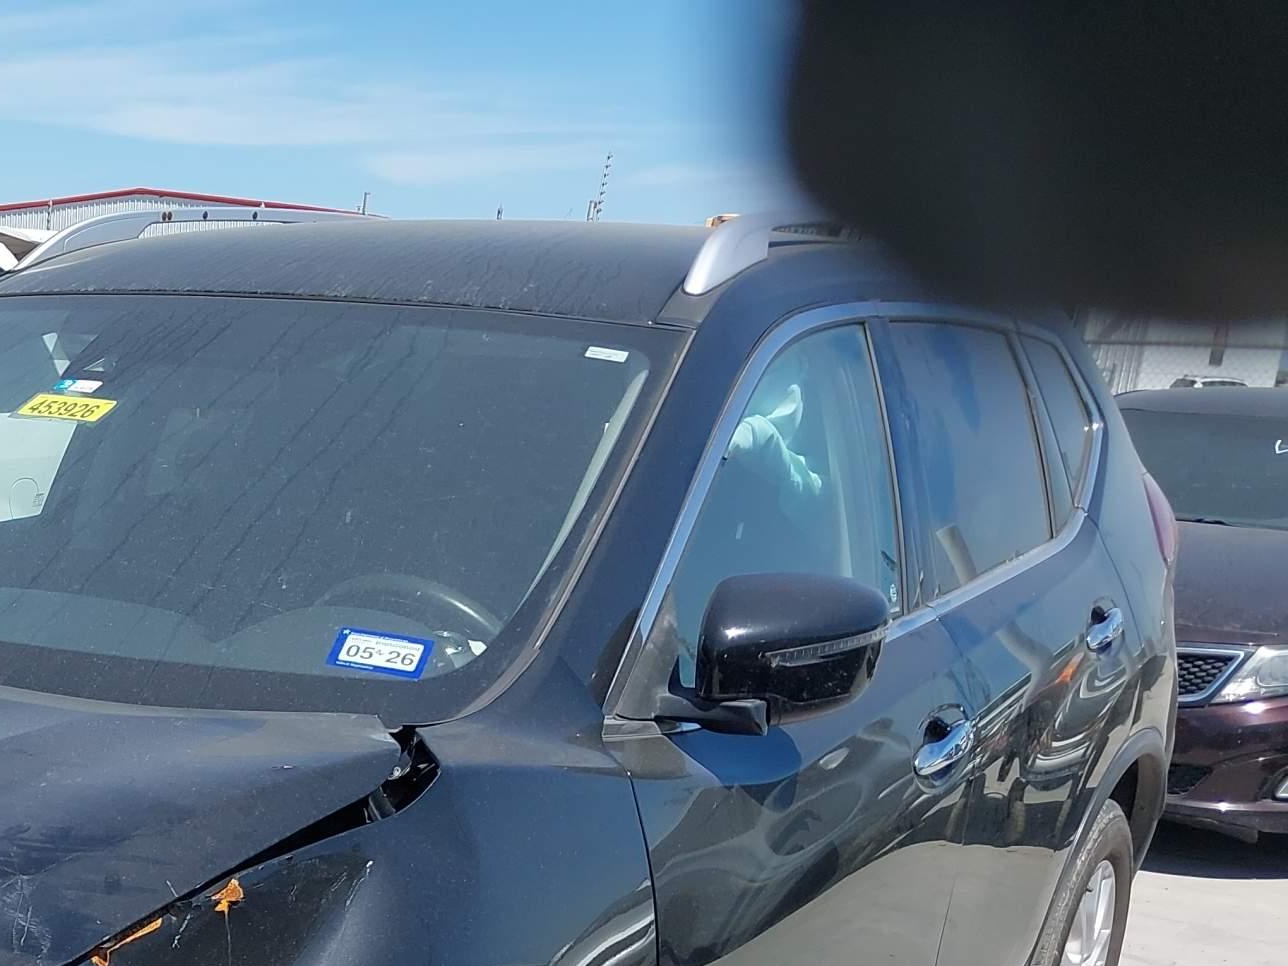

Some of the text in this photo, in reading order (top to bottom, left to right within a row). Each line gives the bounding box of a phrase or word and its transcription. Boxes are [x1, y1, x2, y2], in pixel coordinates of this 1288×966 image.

[29, 400, 100, 418] 453926
[346, 644, 375, 659] 05
[385, 650, 416, 666] 26
